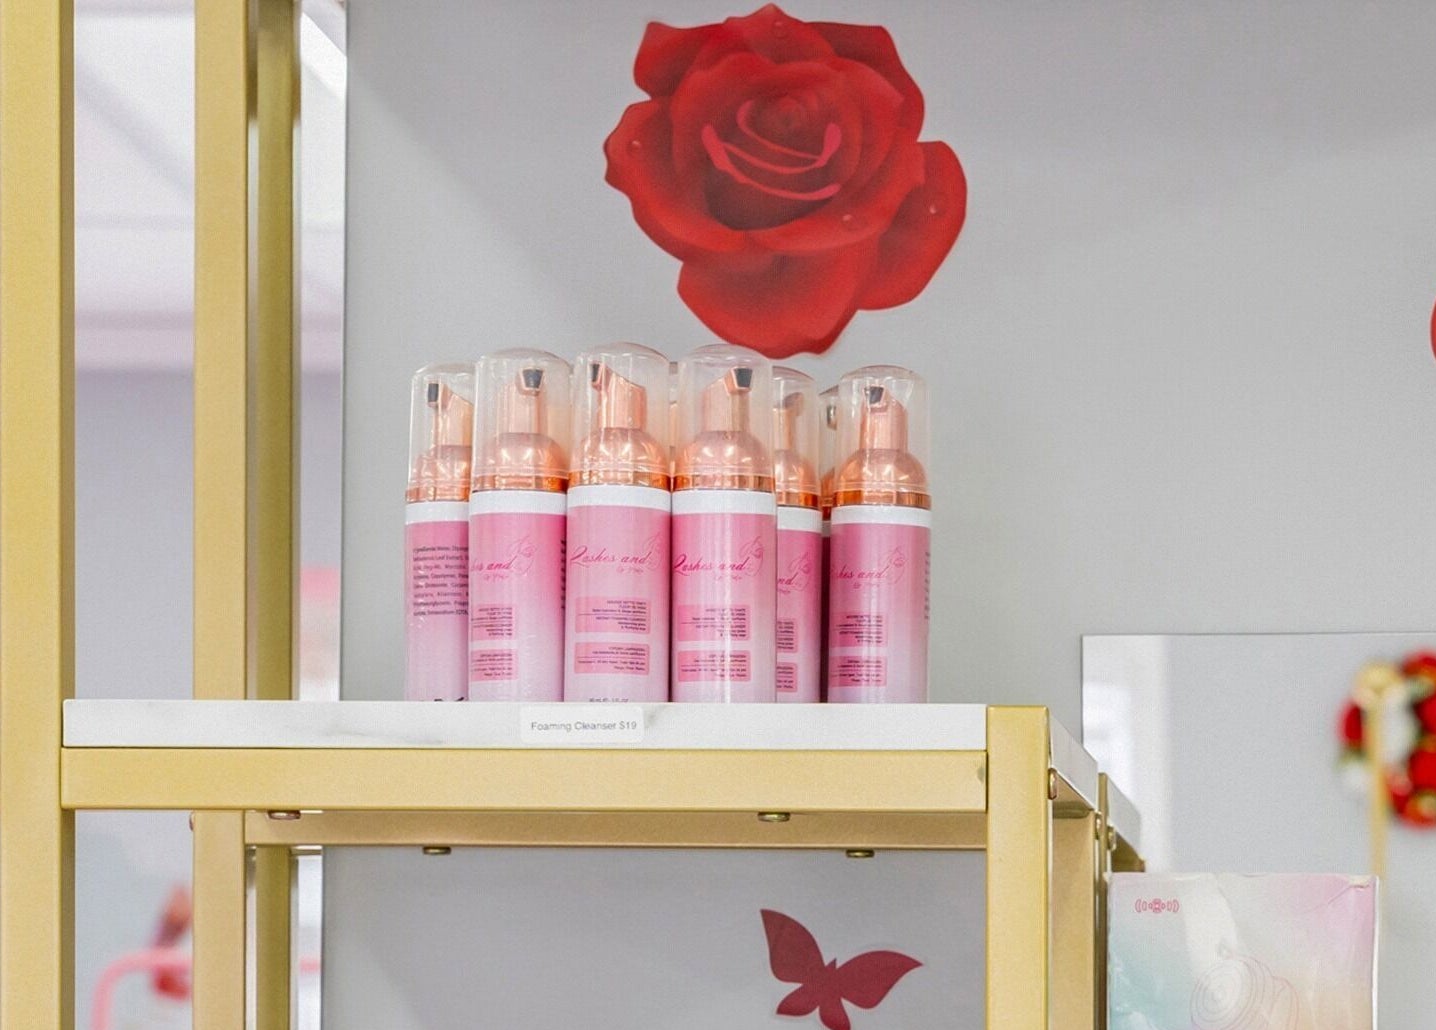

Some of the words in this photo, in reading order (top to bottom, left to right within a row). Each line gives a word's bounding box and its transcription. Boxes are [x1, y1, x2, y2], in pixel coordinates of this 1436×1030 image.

[620, 551, 652, 564] and
[531, 722, 572, 732] Foaming
[574, 721, 617, 730] Cleanser
[619, 721, 637, 730] $19
